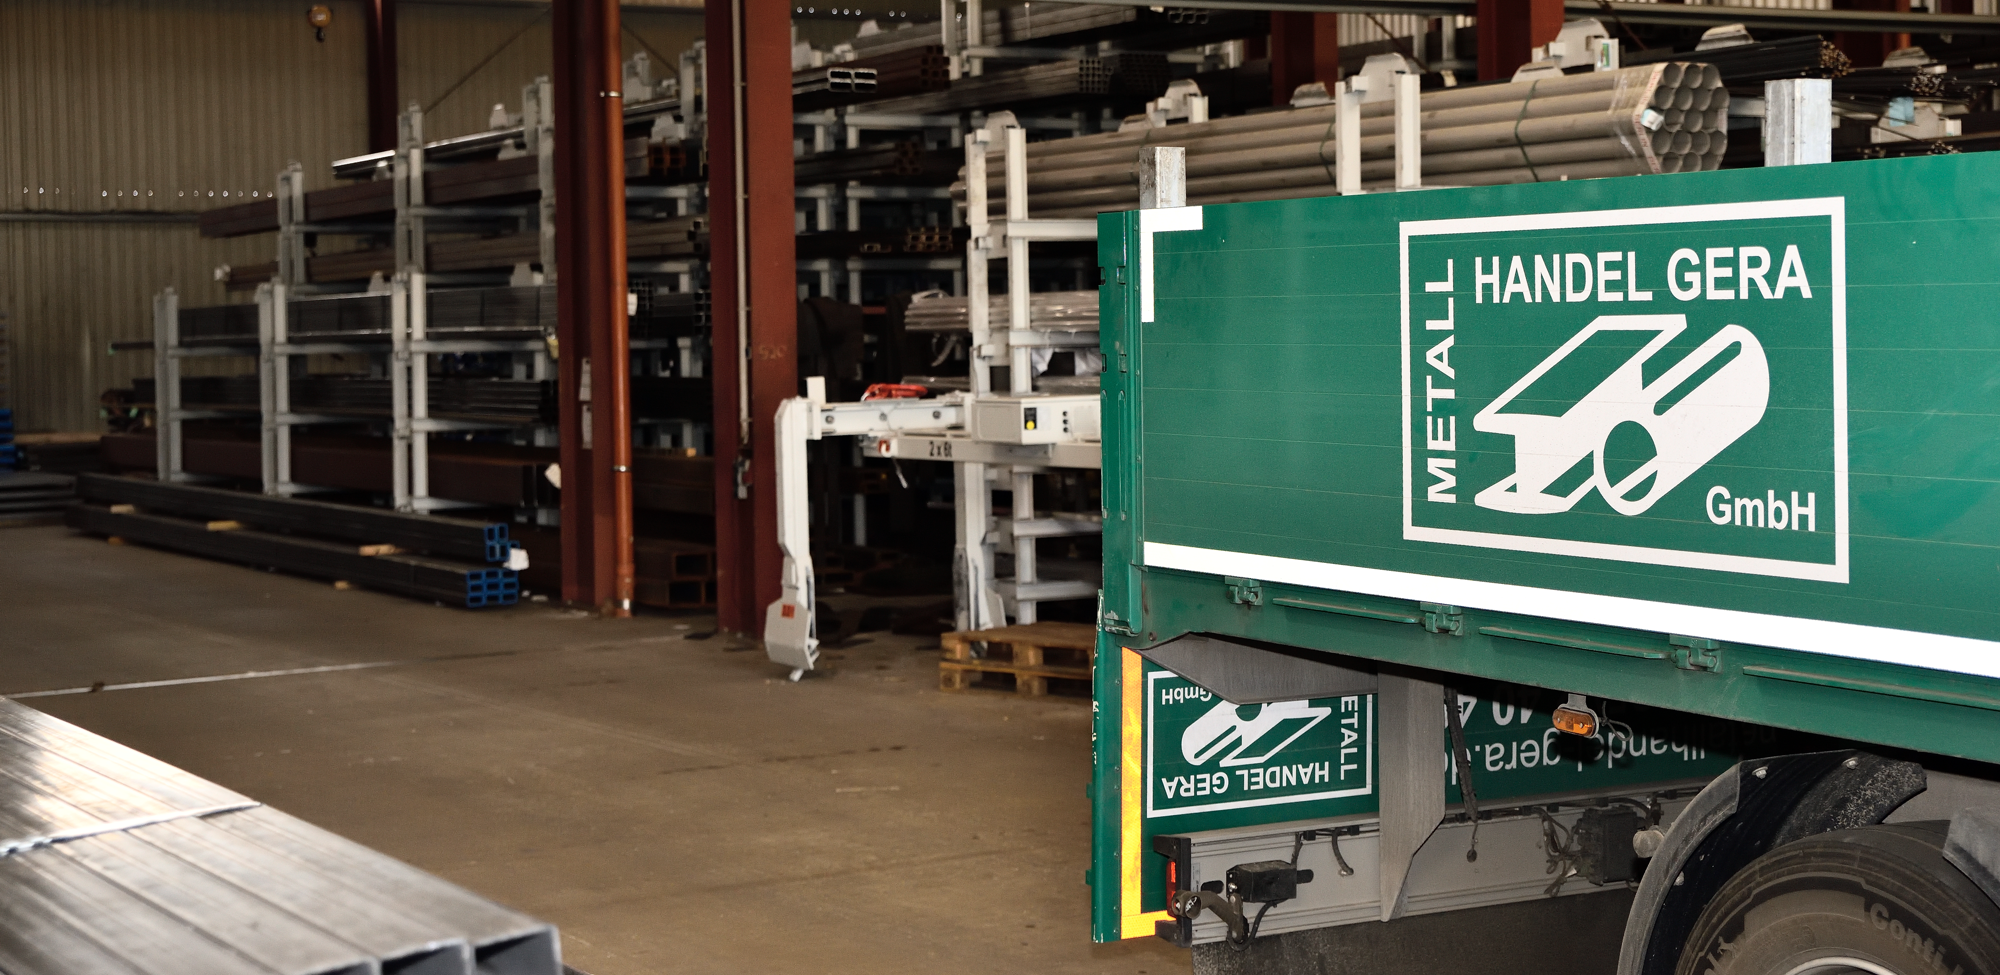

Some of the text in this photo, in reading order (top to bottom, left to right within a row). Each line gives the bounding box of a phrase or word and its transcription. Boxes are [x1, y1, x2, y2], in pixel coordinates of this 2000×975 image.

[1474, 245, 1813, 303] HANDEL GERA
[1426, 258, 1456, 504] METALL
[1705, 486, 1816, 532] GmbH
[1340, 695, 1359, 781] ETALL
[1161, 761, 1330, 799] HANDEL GERA
[1869, 902, 1947, 971] Conti
